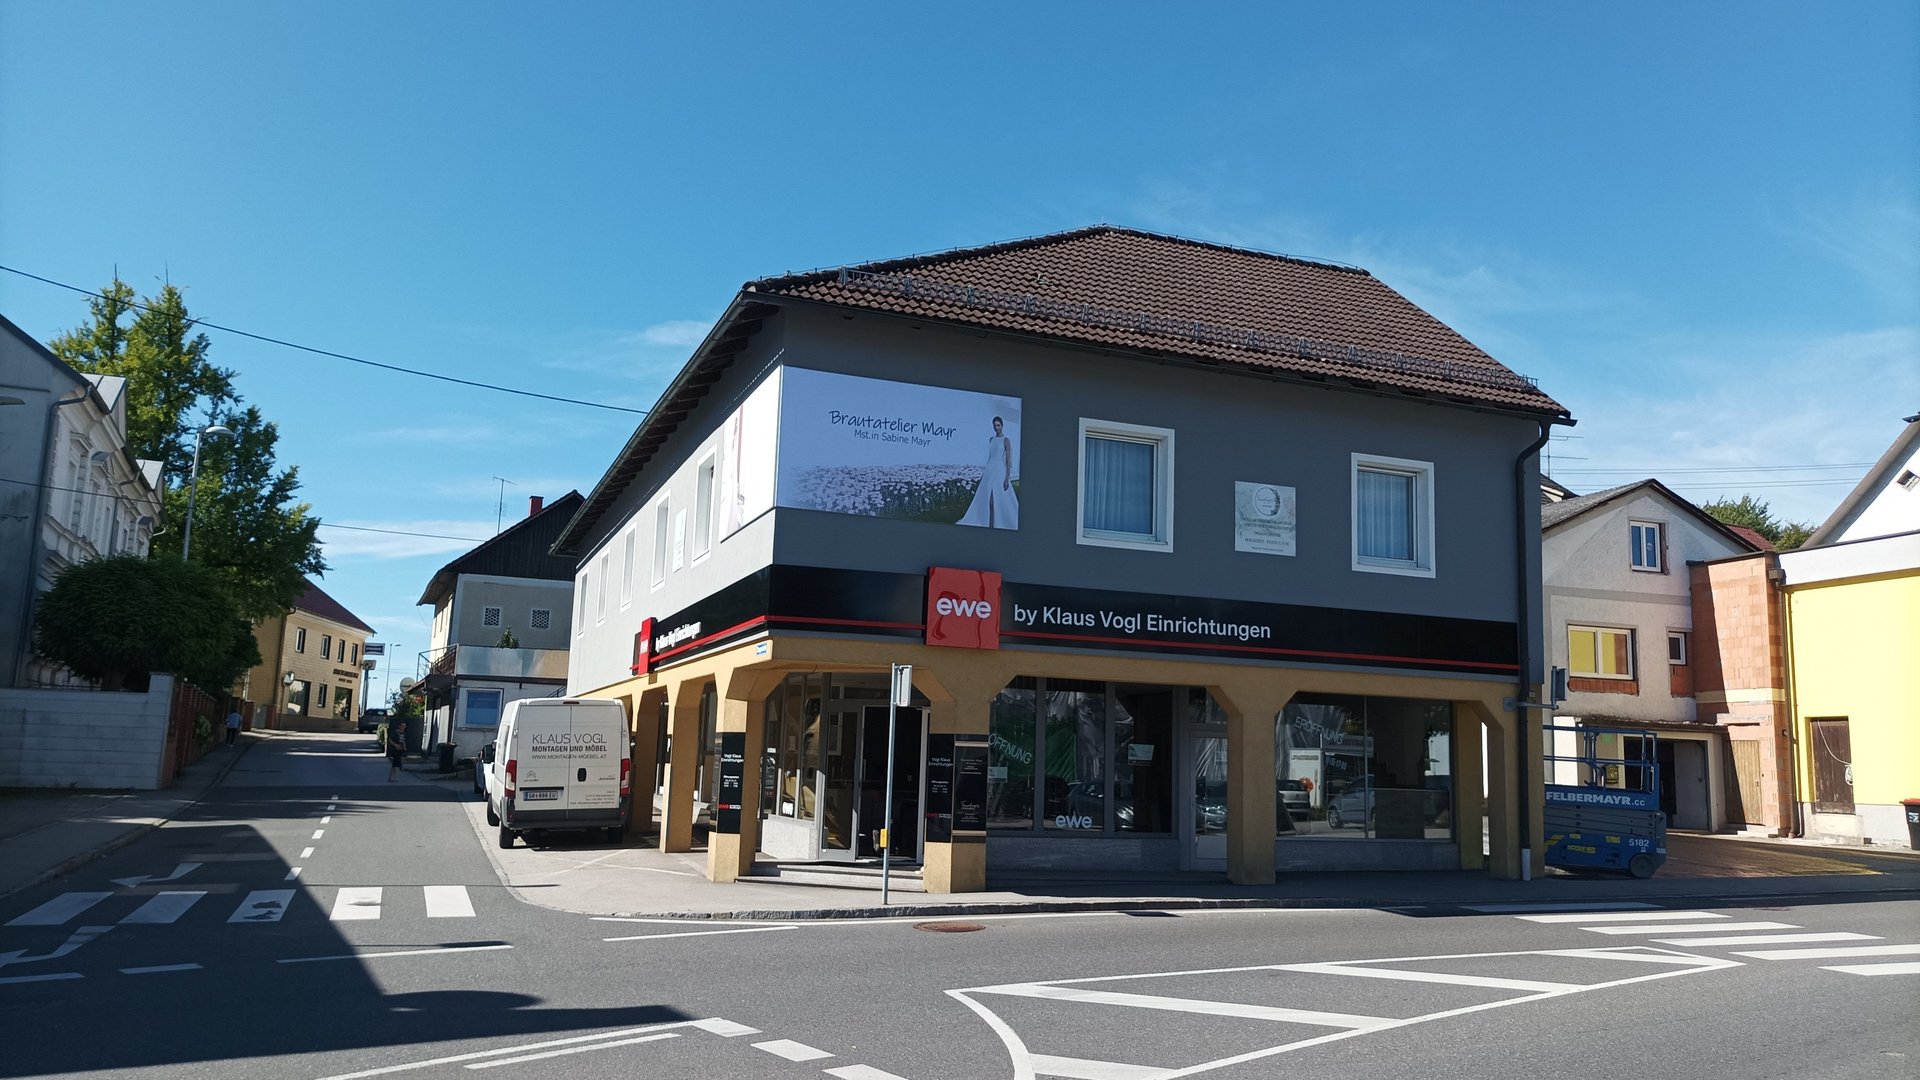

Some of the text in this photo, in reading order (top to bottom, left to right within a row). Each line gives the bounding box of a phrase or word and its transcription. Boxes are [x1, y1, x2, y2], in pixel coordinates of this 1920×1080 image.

[828, 410, 957, 441] Brautatelier Mayr
[854, 429, 932, 448] Mst.in Sabine Mayr
[936, 597, 992, 619] ewe
[1014, 604, 1271, 641] by Klaus Vogl Einrichtungen
[532, 733, 607, 744] KLAUS VOGL
[584, 744, 607, 752] MÖBEL
[1546, 791, 1645, 806] FELBERMAYR.cc
[1055, 815, 1093, 828] ewe
[1629, 839, 1649, 847] 5182
